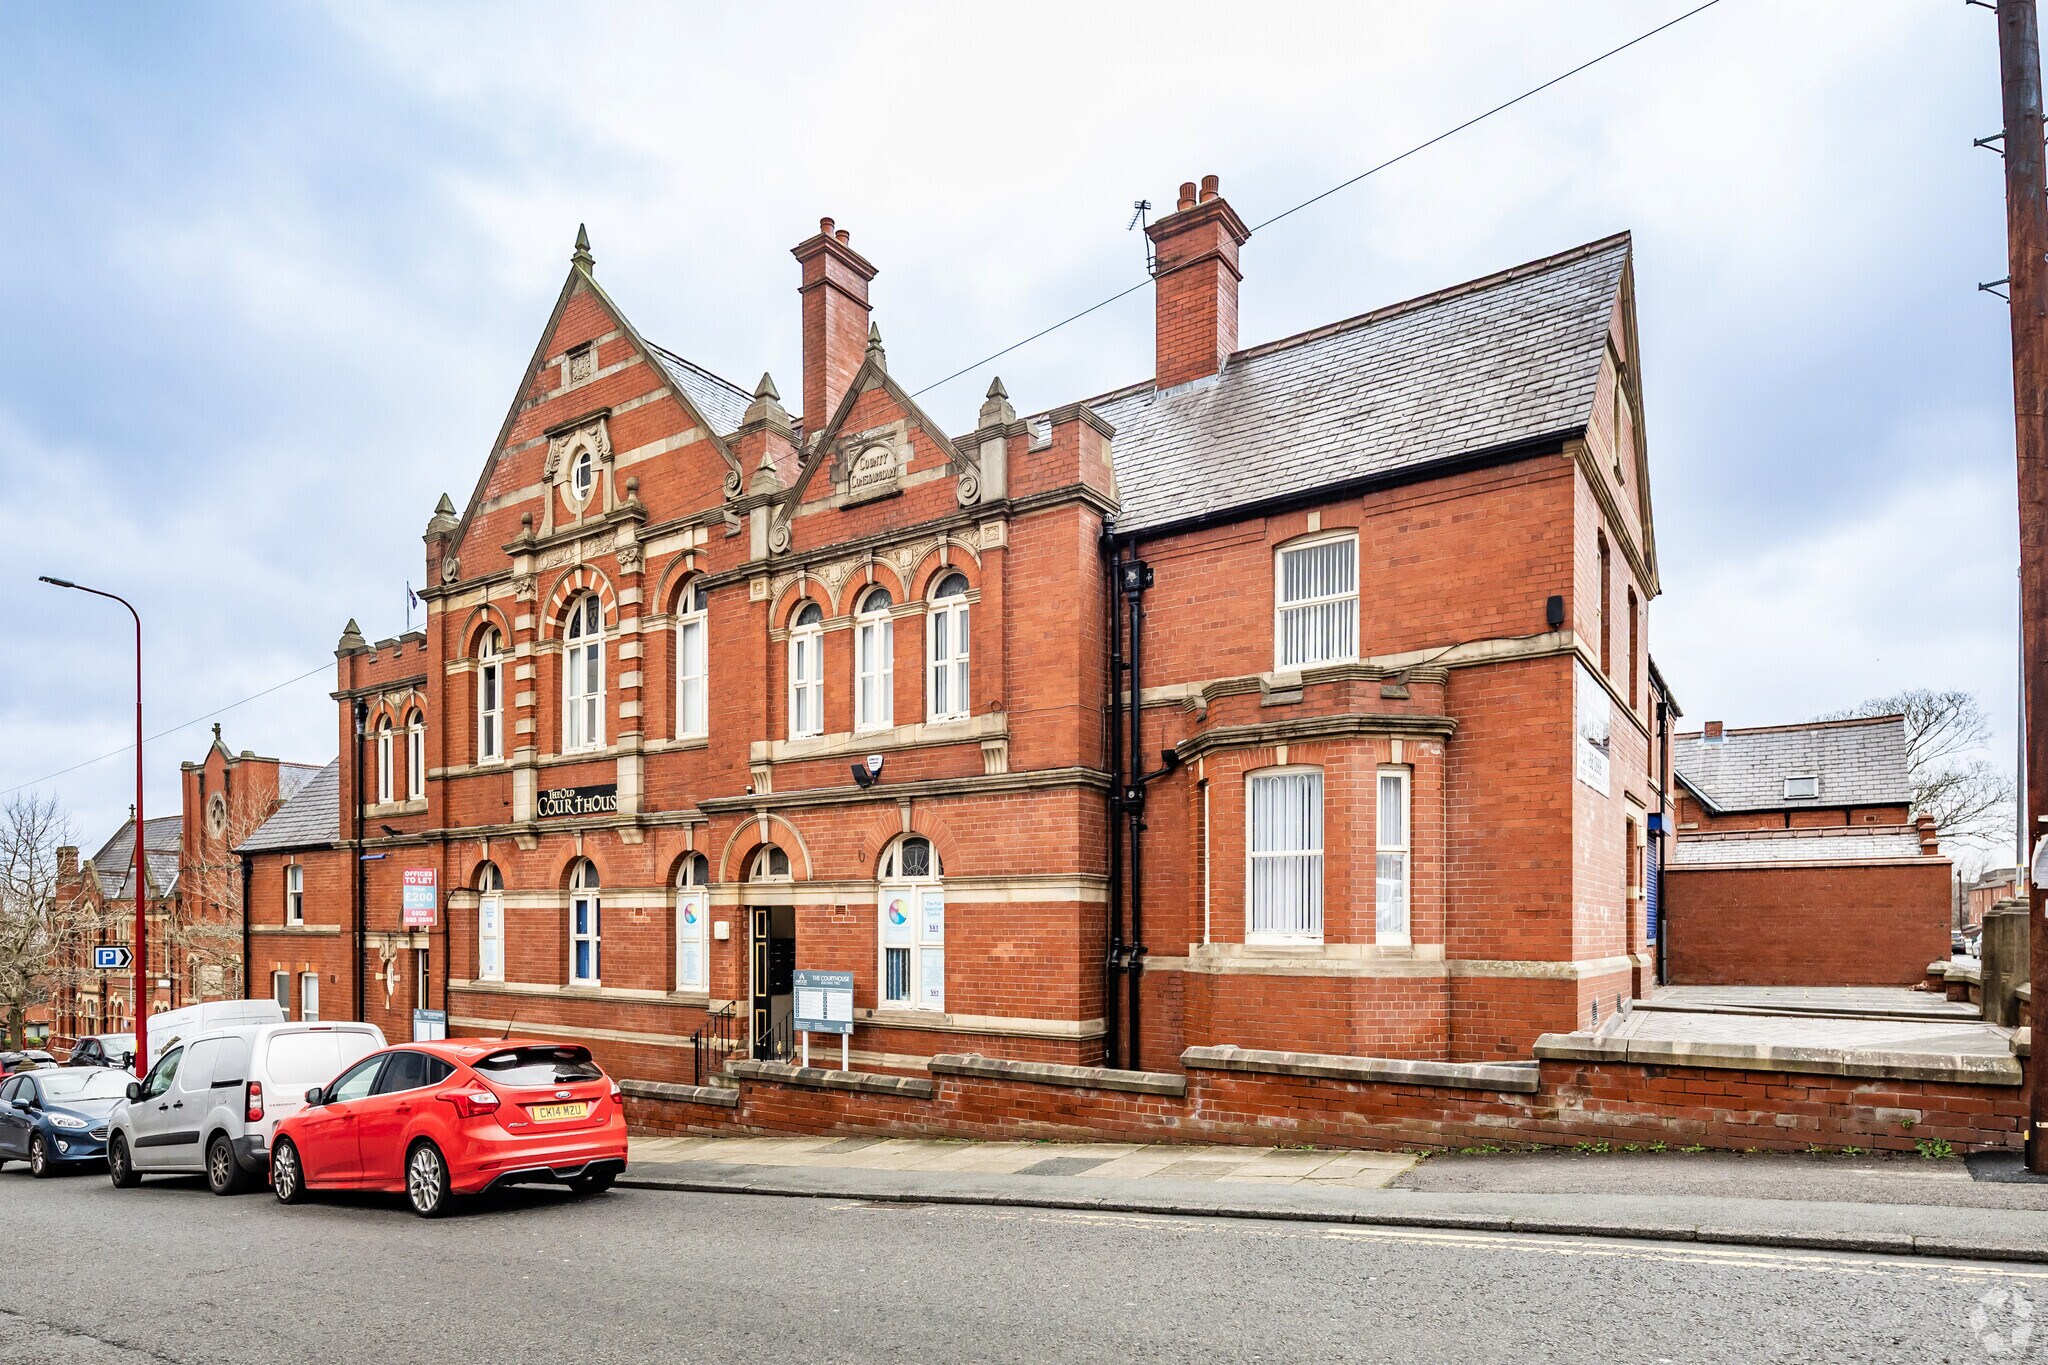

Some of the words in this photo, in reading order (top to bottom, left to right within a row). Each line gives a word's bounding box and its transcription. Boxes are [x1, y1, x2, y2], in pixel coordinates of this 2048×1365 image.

[537, 791, 618, 817] COURTHOUS
[405, 892, 433, 902] £200
[102, 951, 115, 964] P
[540, 1106, 561, 1118] CK14
[563, 1105, 581, 1116] MZU
